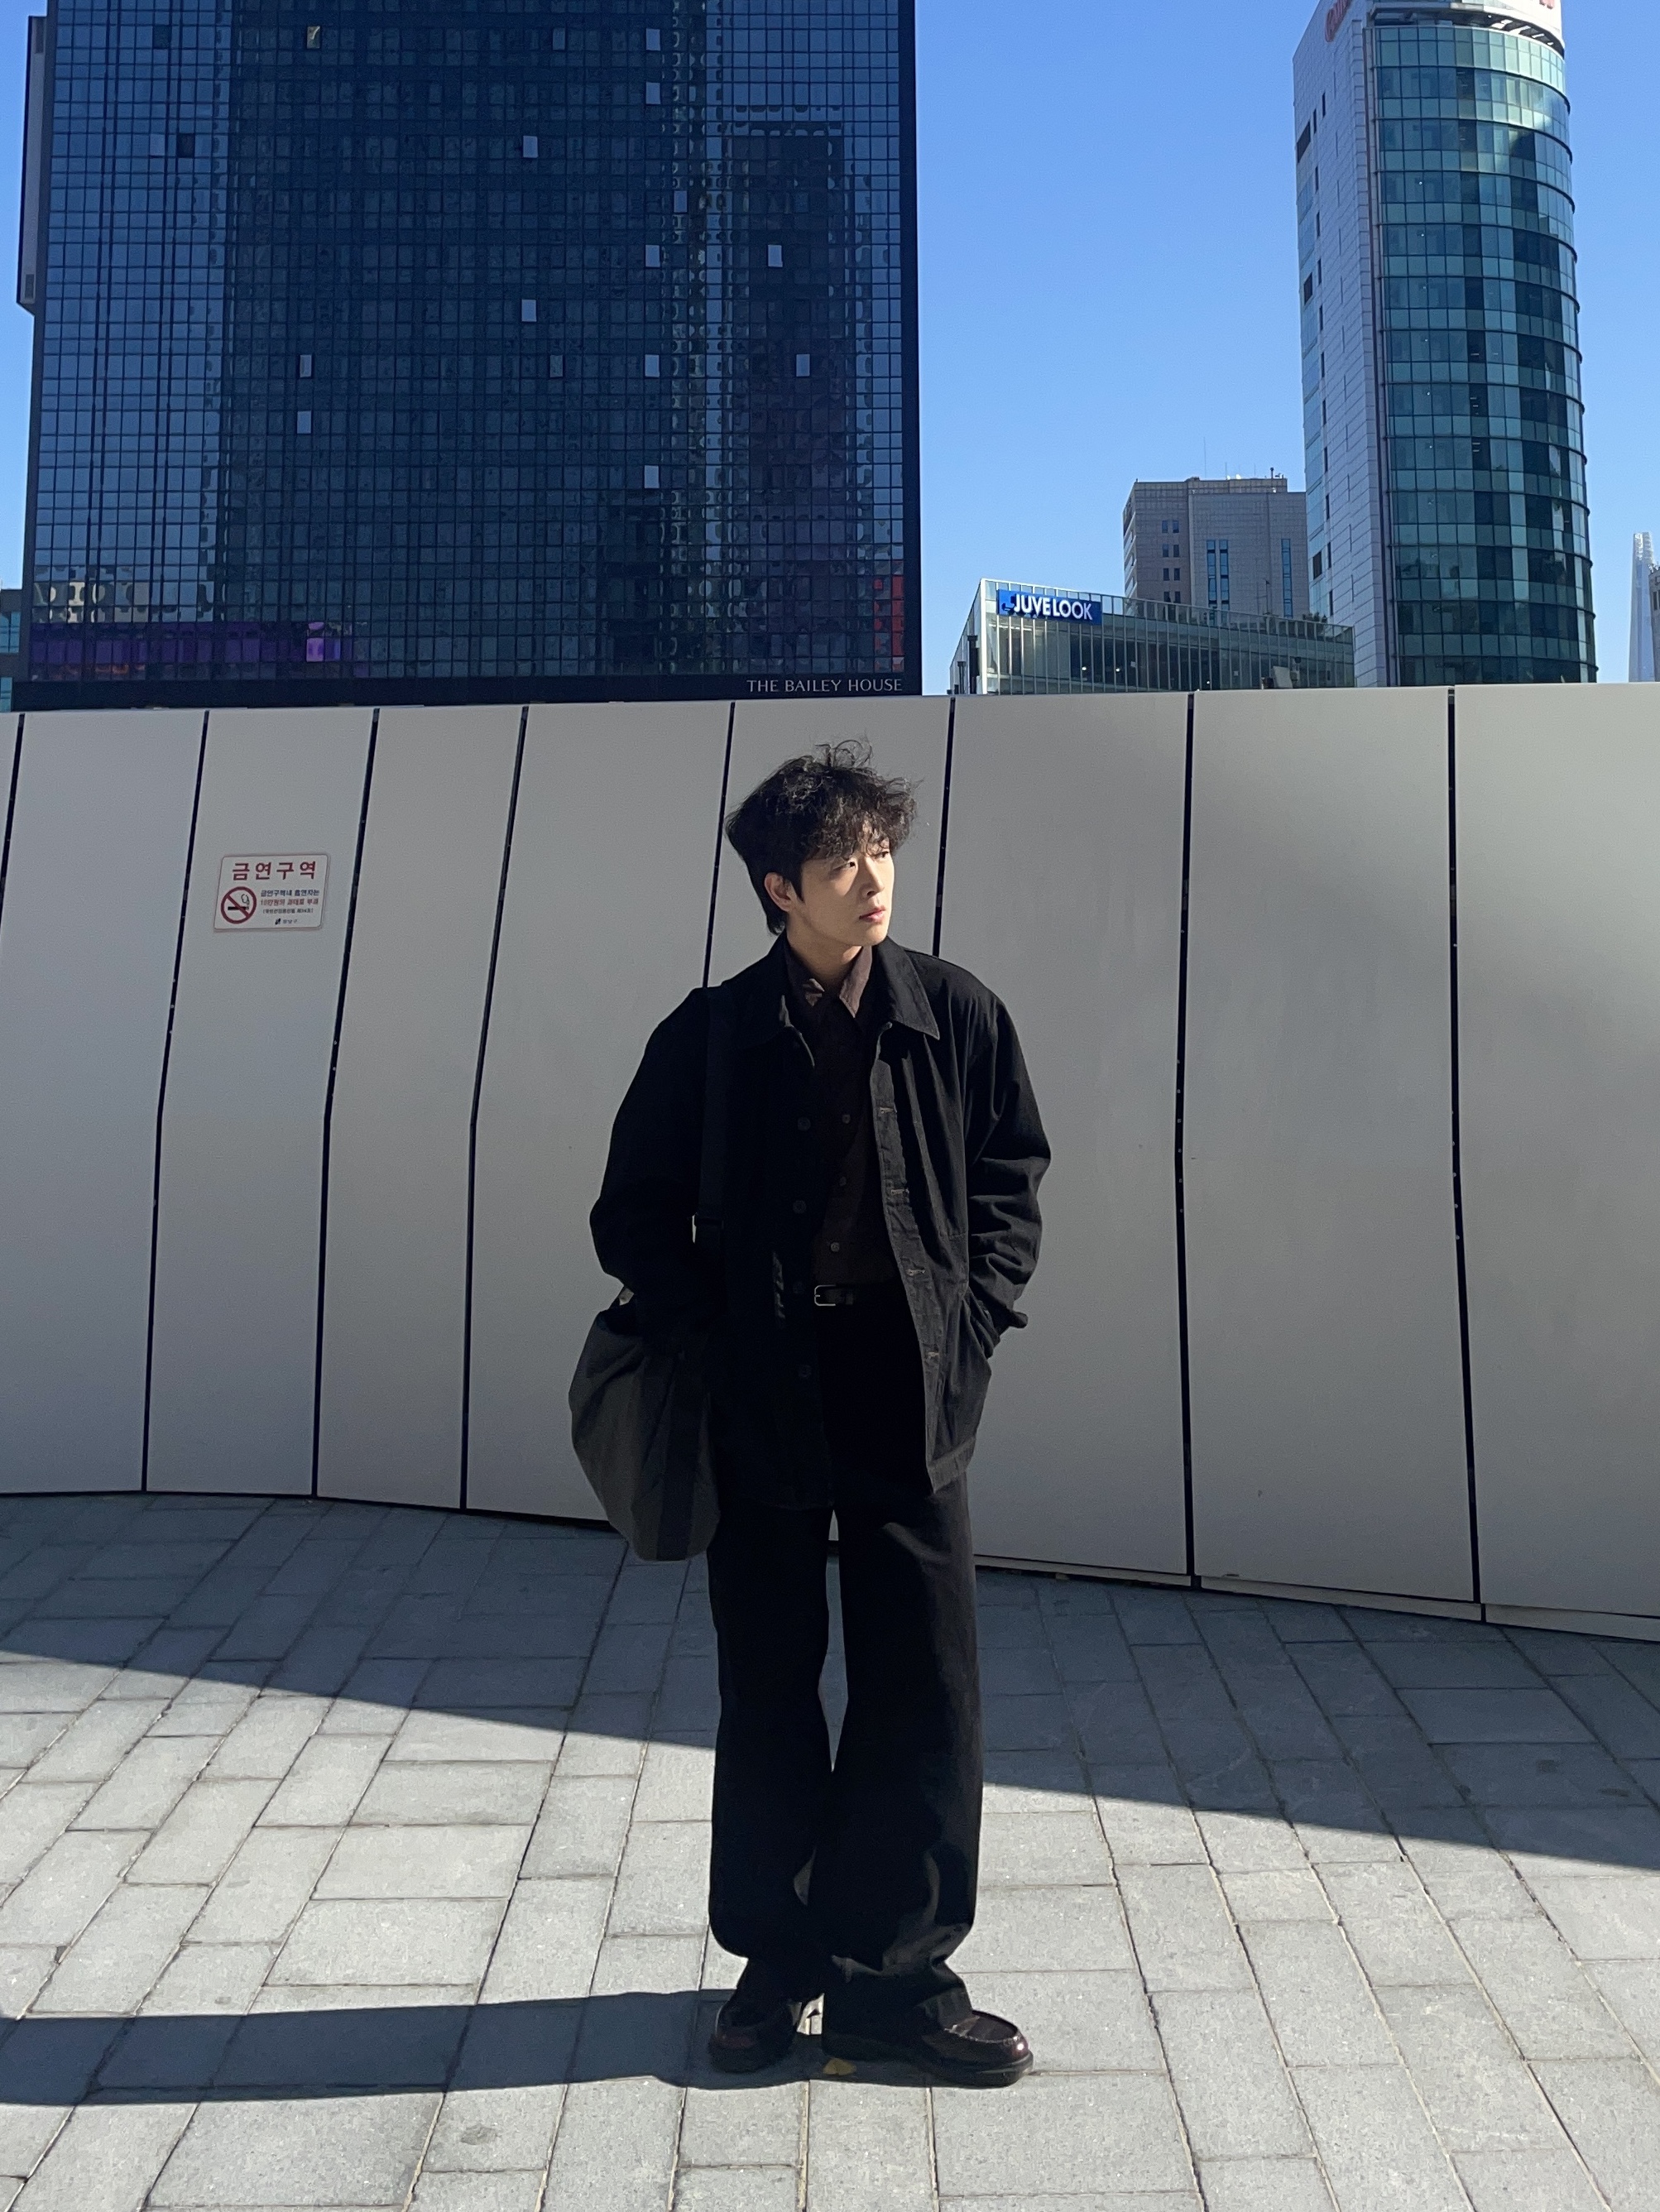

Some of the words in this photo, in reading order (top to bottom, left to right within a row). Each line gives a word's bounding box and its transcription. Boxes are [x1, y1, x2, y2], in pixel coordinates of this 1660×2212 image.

[1014, 593, 1093, 621] JUVELOOK
[746, 679, 779, 693] THE
[784, 679, 842, 693] BAILEY
[848, 679, 903, 692] HOUSE
[233, 861, 316, 881] 금연구역
